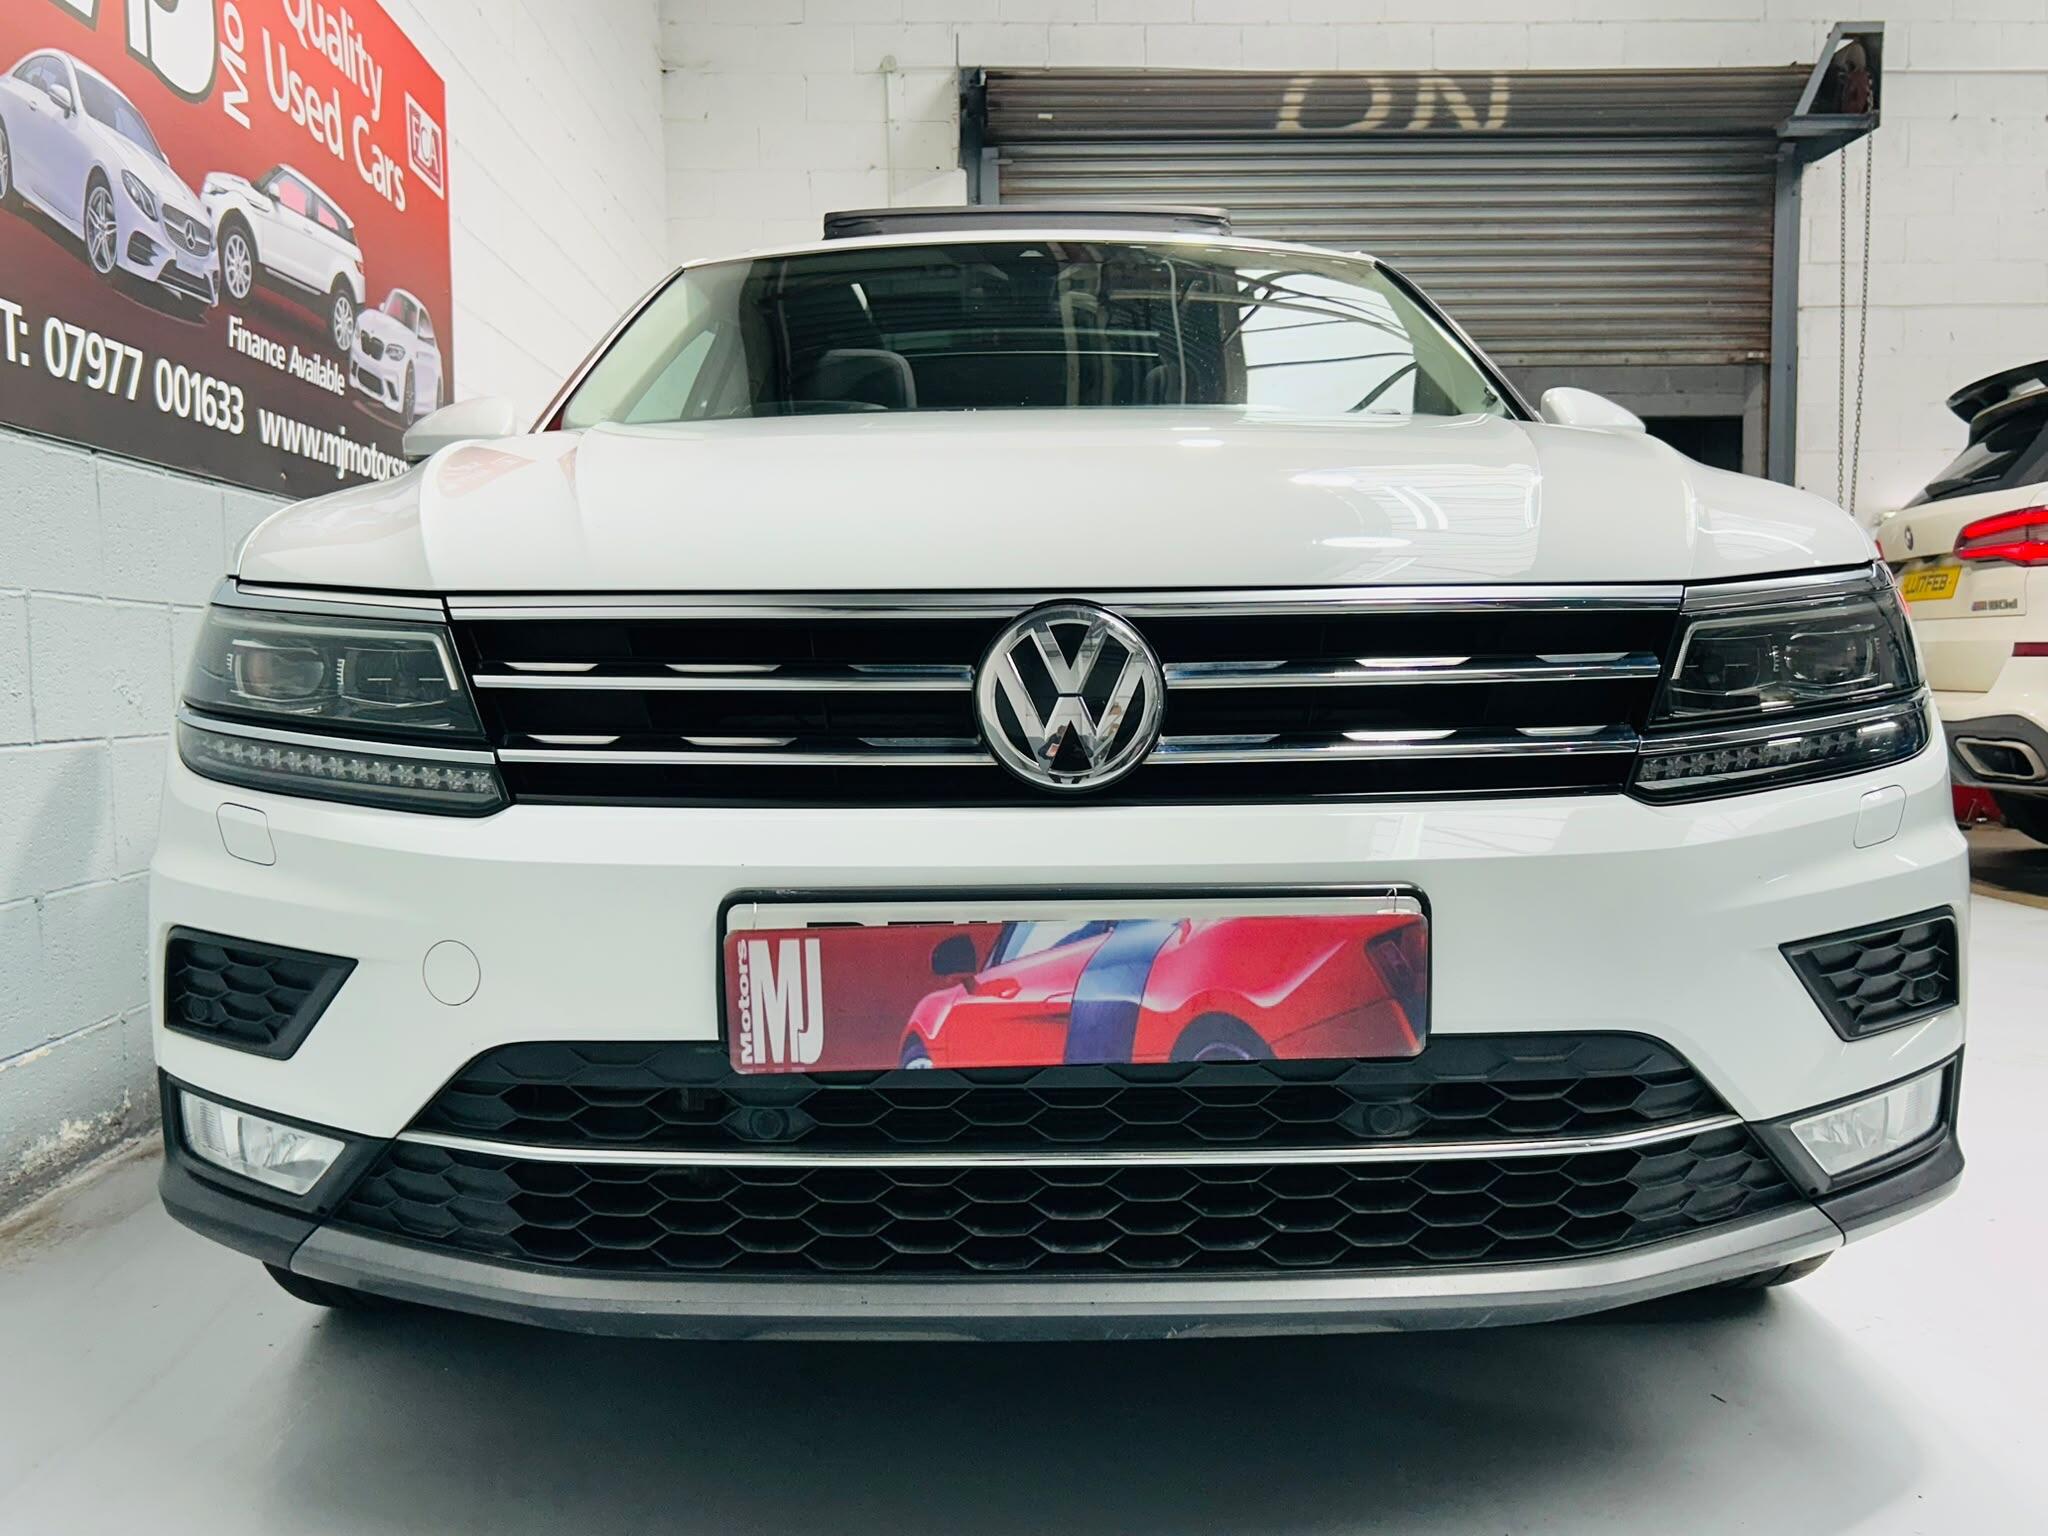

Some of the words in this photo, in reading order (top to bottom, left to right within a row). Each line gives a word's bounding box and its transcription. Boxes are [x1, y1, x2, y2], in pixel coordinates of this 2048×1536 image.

[262, 26, 345, 161] Used
[352, 115, 406, 212] Cars
[0, 298, 31, 367] T:
[44, 316, 143, 401] 07977
[155, 358, 245, 435] 001633
[258, 408, 411, 481] www.mjmotors
[228, 315, 287, 371] Finance
[288, 345, 346, 396] Available
[737, 938, 753, 1065] Motors
[748, 937, 824, 1065] MJ
